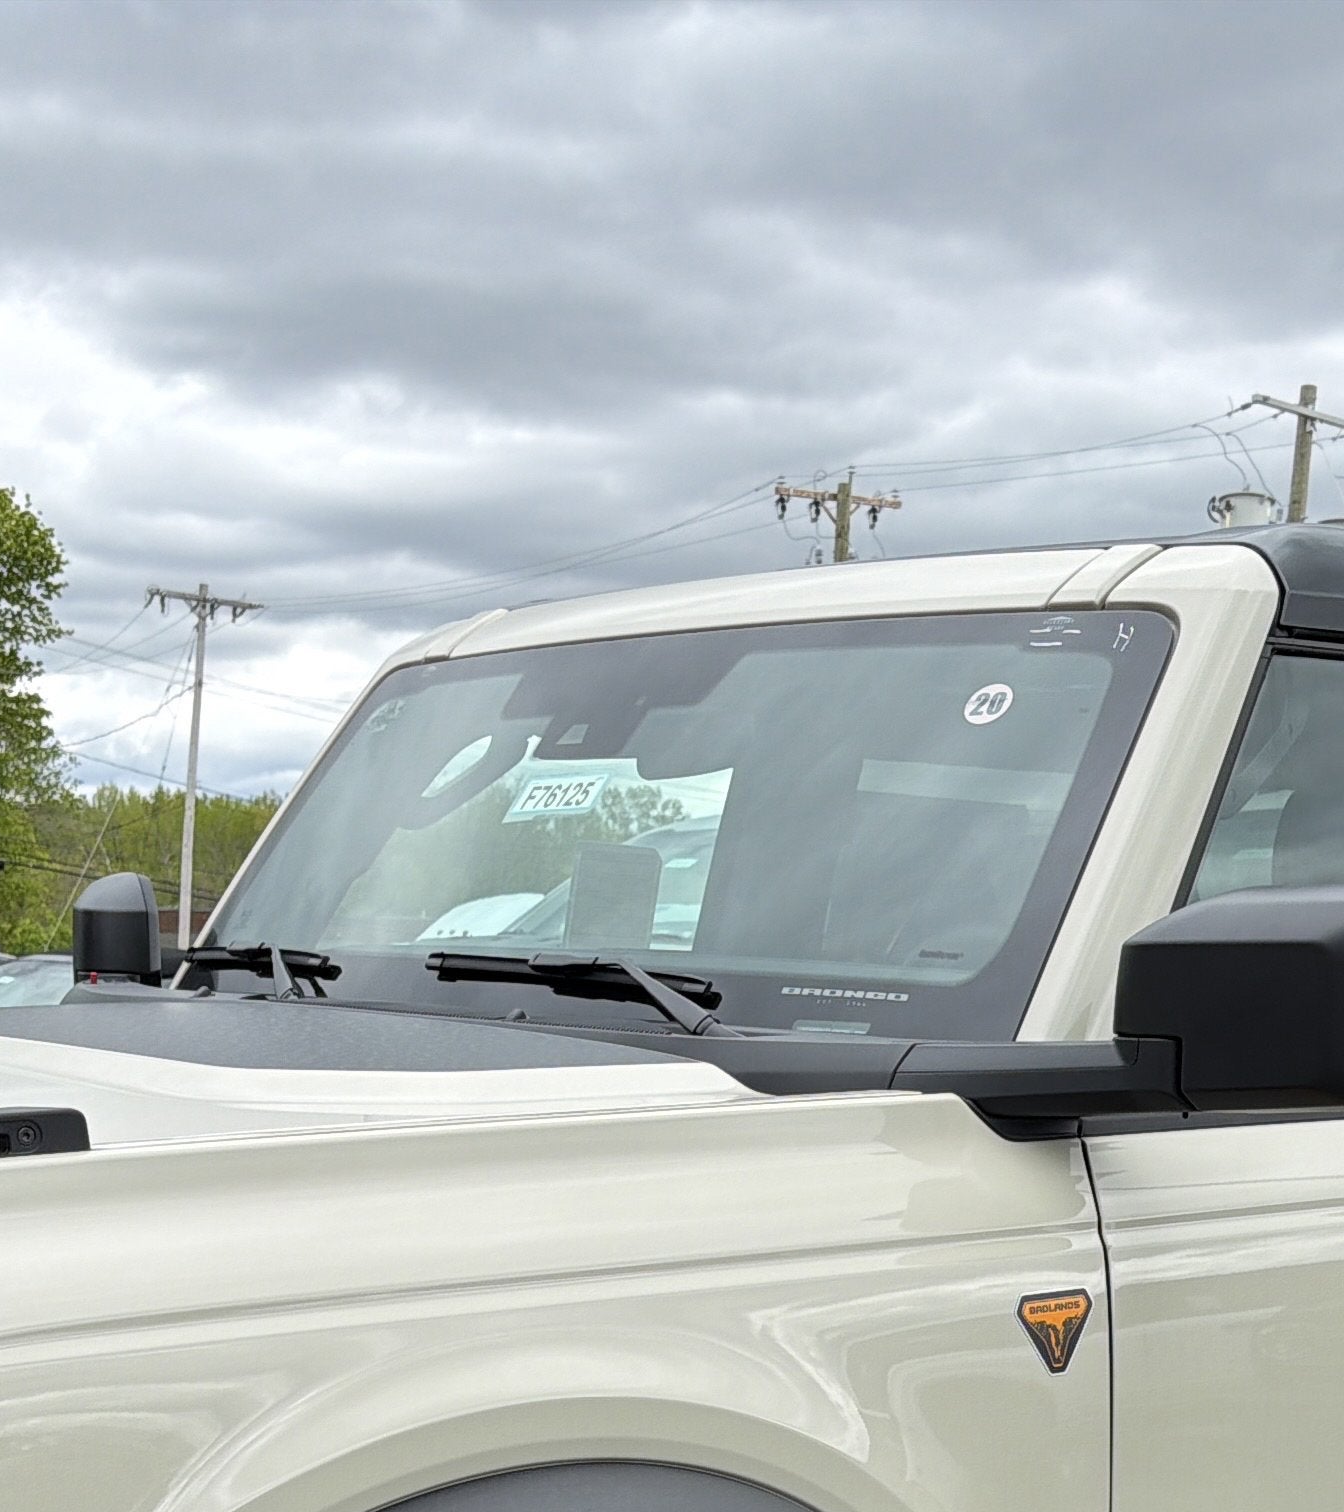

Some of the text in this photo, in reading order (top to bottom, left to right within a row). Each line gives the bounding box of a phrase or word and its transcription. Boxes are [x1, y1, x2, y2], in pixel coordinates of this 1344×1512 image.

[968, 691, 1009, 717] 20
[519, 781, 596, 811] F76125
[781, 986, 909, 1001] BRONCO
[1028, 1300, 1081, 1315] BADLANDS
